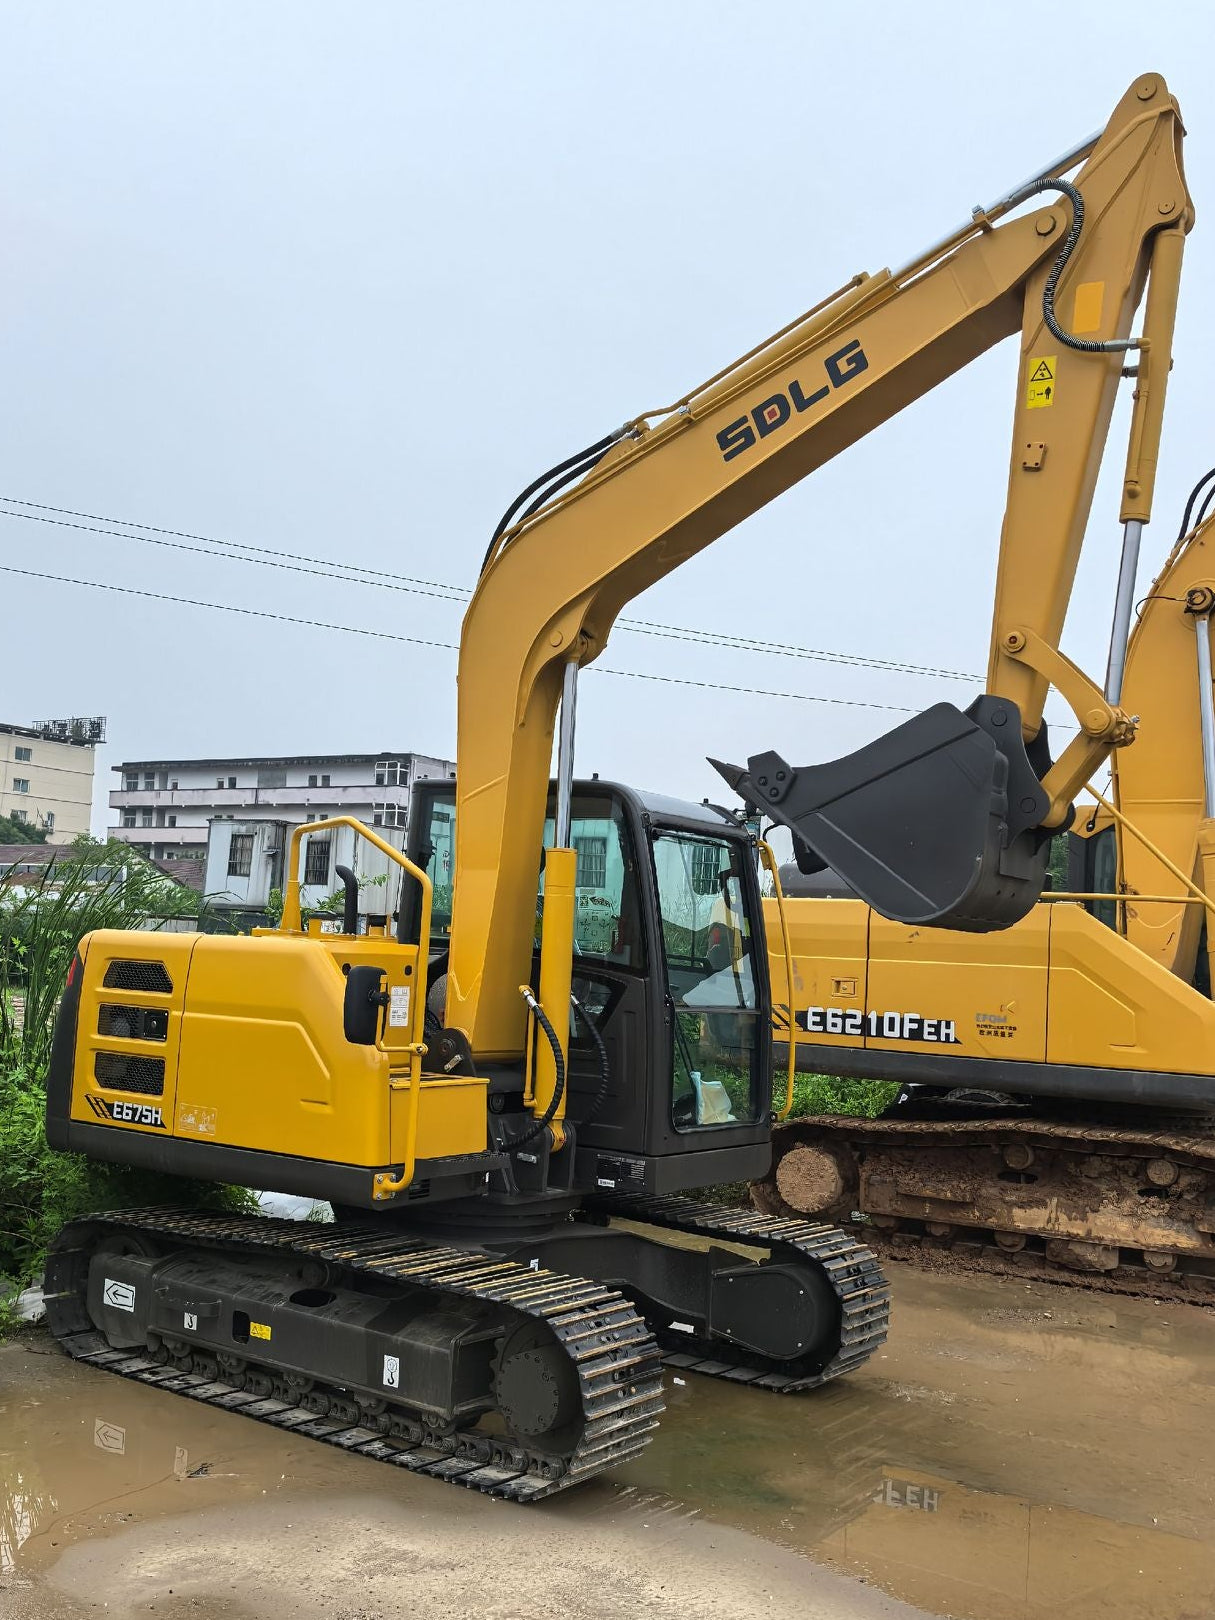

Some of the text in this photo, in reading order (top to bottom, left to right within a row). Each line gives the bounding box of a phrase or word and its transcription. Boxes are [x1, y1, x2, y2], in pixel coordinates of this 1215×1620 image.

[716, 339, 869, 462] SDLG
[807, 1006, 955, 1042] E6210FEH
[113, 1101, 161, 1124] E675H
